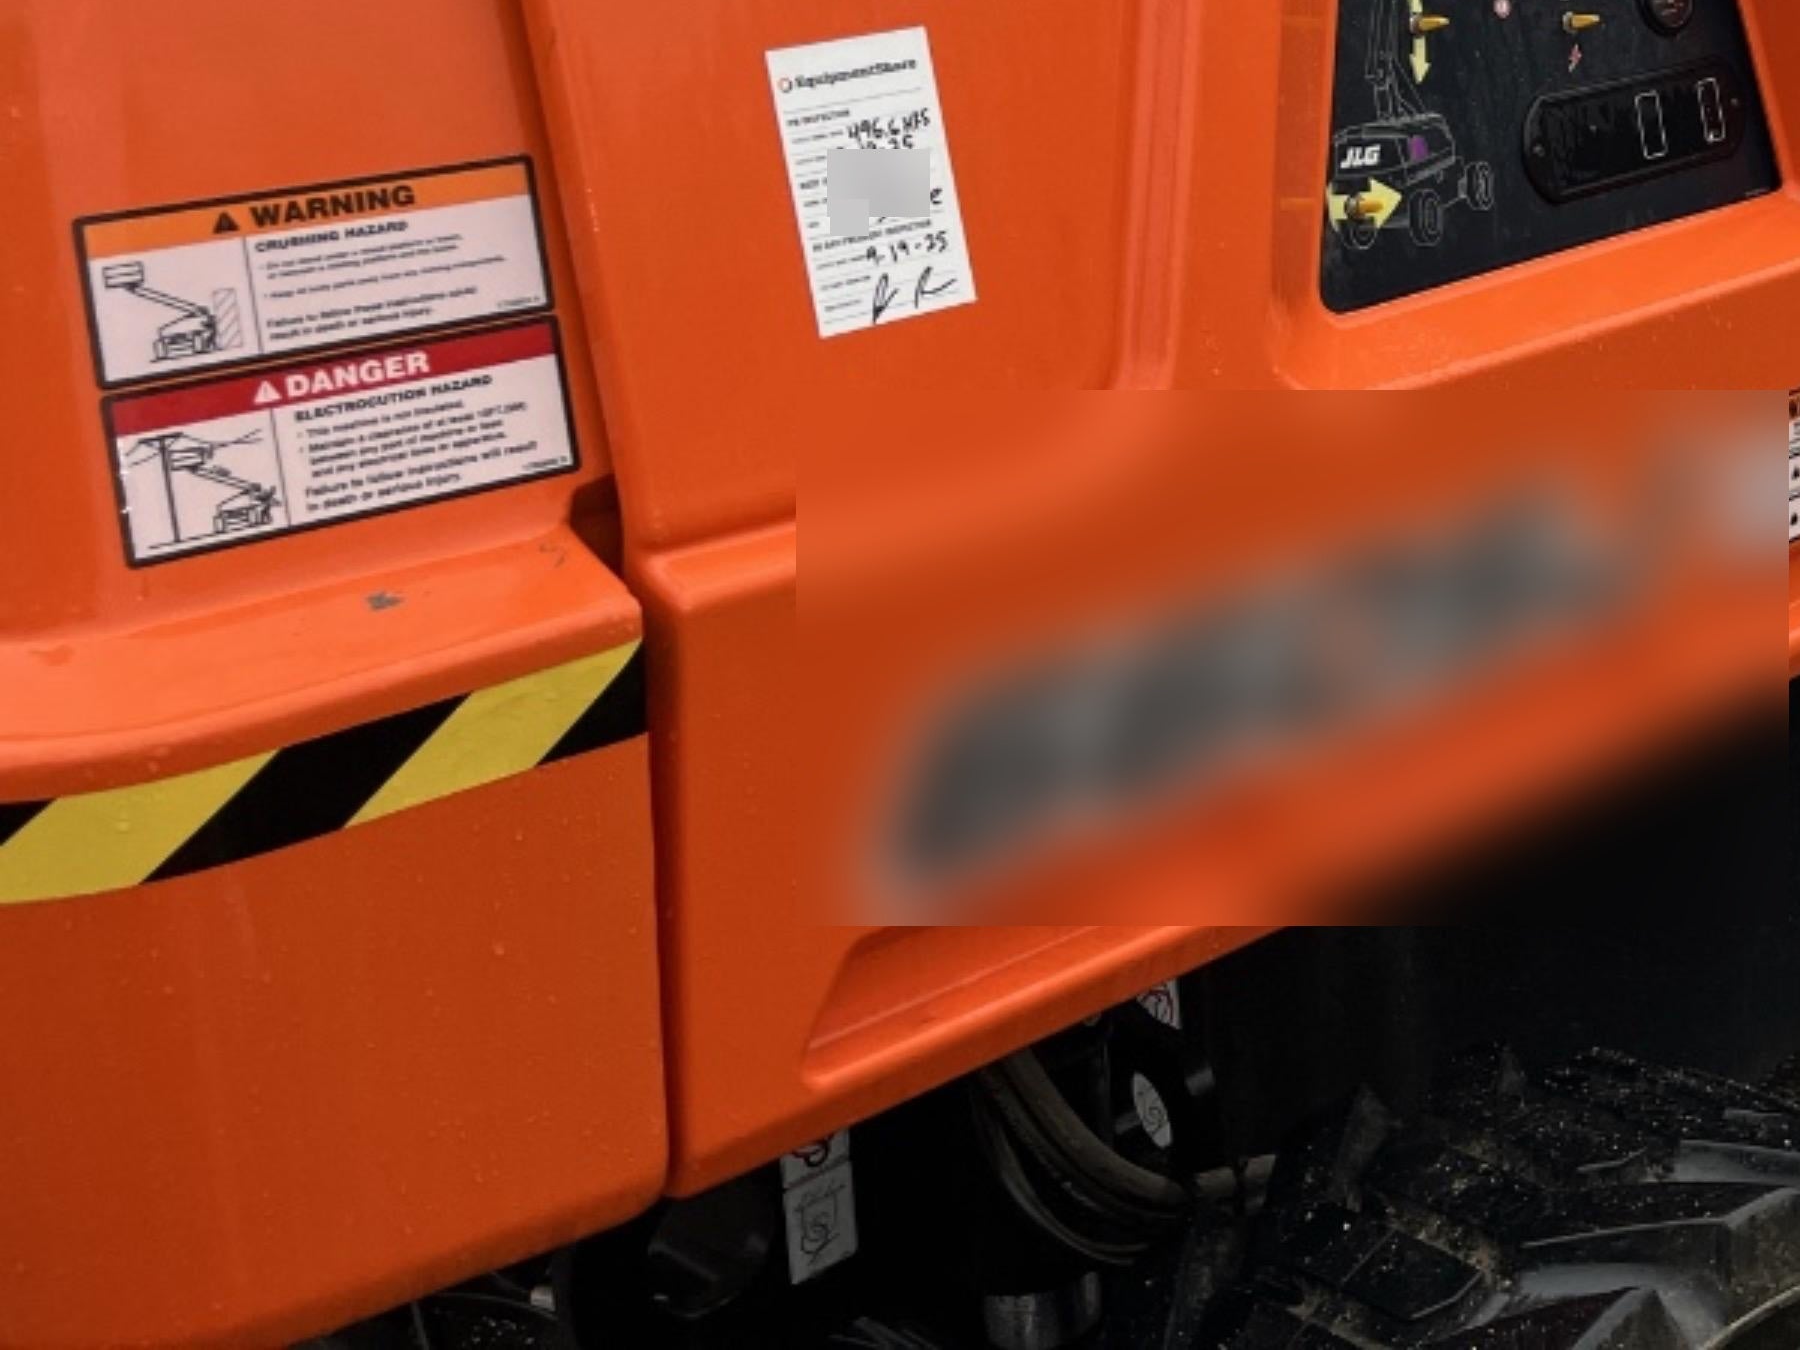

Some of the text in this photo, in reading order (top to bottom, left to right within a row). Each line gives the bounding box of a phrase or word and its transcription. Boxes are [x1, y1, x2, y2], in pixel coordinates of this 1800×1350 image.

[1340, 143, 1381, 169] JLG
[250, 185, 415, 229] WARNING
[344, 221, 408, 238] HAZARD
[285, 351, 430, 398] DANGER
[431, 374, 493, 396] HAZARD
